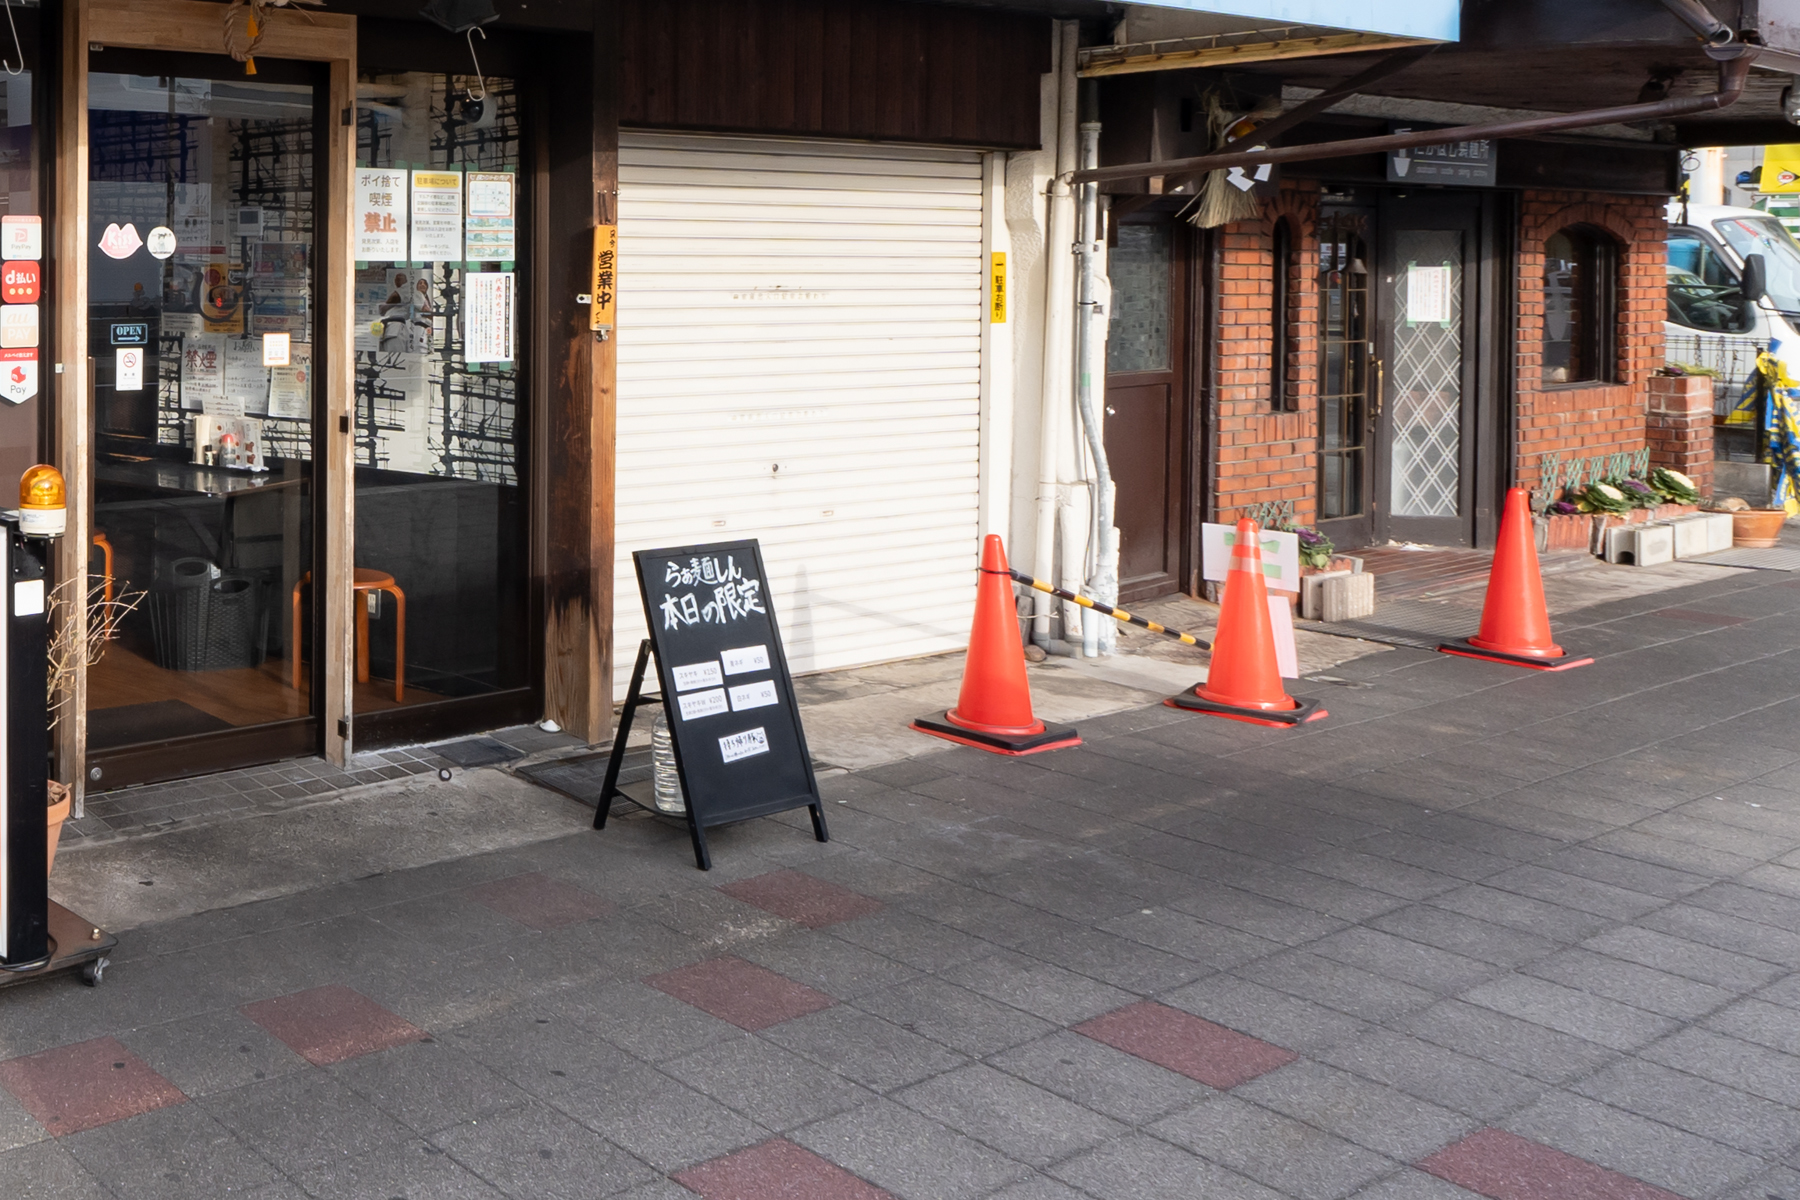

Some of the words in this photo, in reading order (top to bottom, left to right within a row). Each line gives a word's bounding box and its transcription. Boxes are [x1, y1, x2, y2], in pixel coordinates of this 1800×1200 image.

[369, 192, 393, 207] 喫煙
[364, 211, 398, 234] 禁止
[107, 230, 133, 248] Kiss
[5, 269, 36, 285] d払い
[596, 250, 614, 310] 営業中
[995, 275, 1004, 320] 駐車お断り
[6, 312, 32, 324] au
[8, 328, 31, 340] PAY
[116, 326, 142, 336] OPEN
[185, 349, 217, 369] 禁煙
[10, 384, 27, 395] Pay
[665, 555, 742, 588] らぁ麺しん
[660, 578, 766, 631] 本日の限定
[678, 670, 698, 680] スキヤキ
